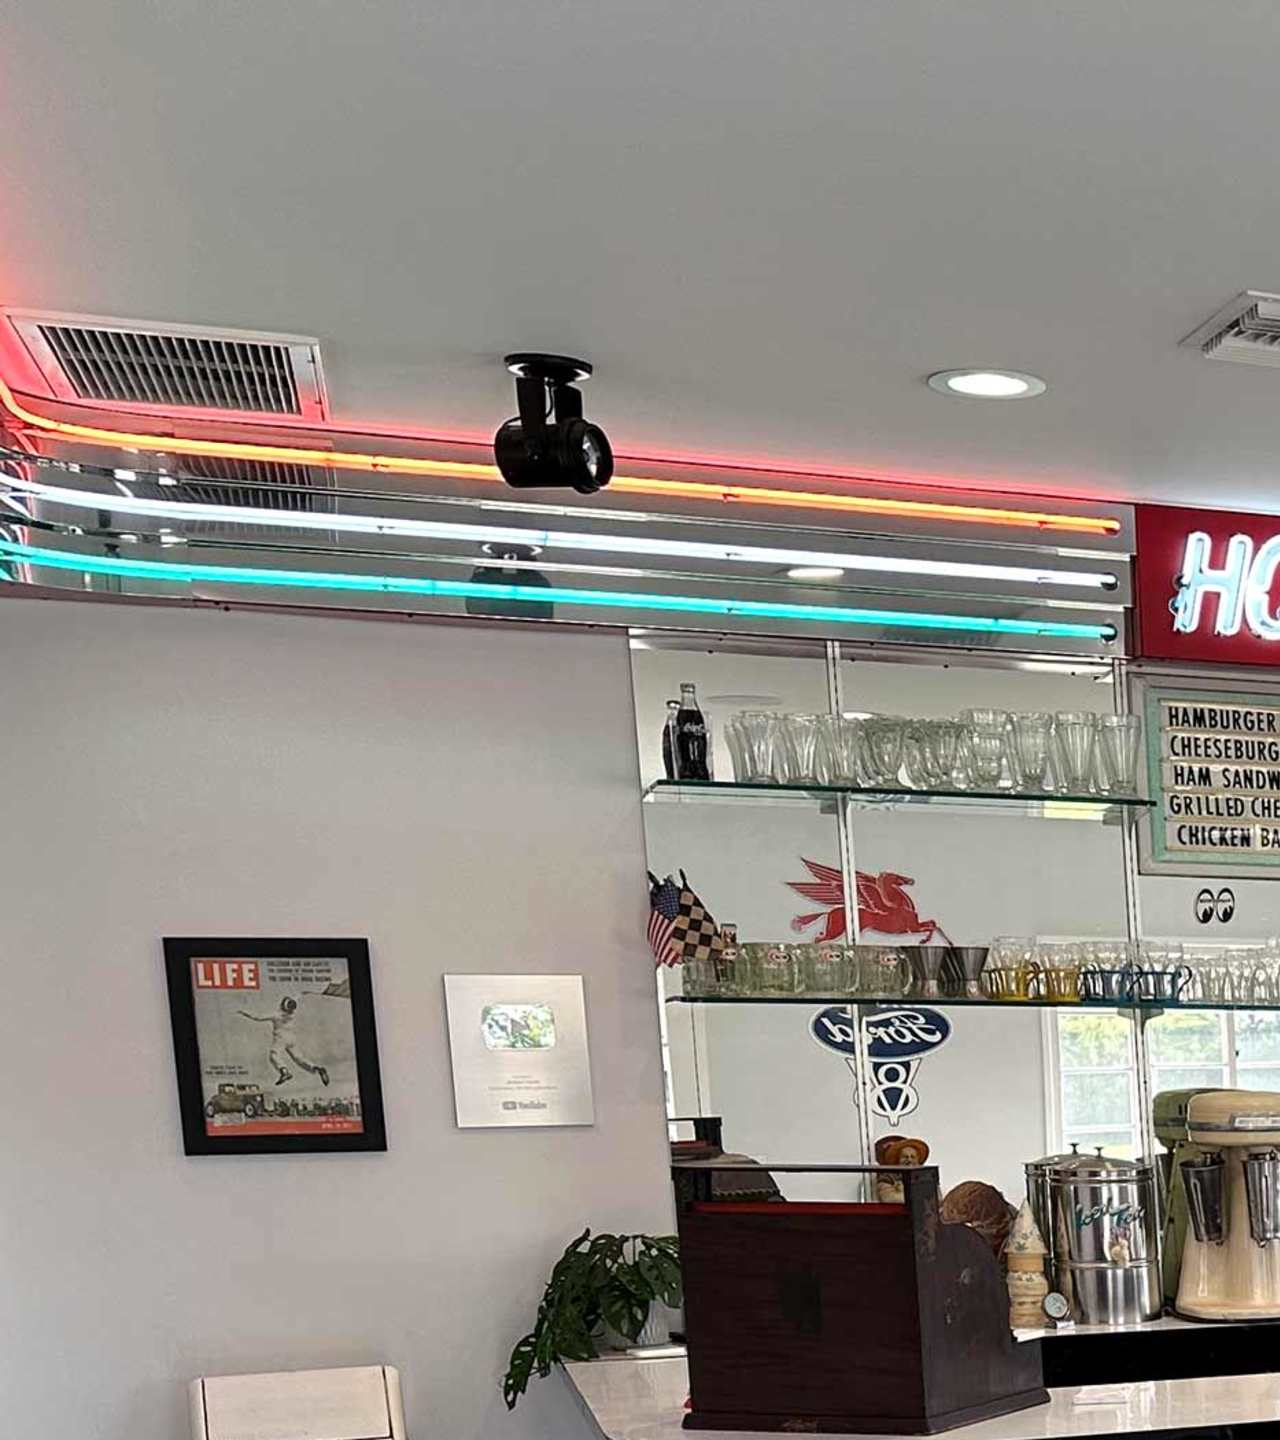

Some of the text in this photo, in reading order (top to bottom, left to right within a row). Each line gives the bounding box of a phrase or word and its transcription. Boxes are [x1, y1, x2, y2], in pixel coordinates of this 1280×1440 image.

[1168, 706, 1277, 732] HAMBURGER
[1174, 765, 1212, 787] HAM
[1170, 794, 1245, 817] GRILLED
[1177, 825, 1250, 847] CHICKEN
[197, 962, 257, 987] LIFE
